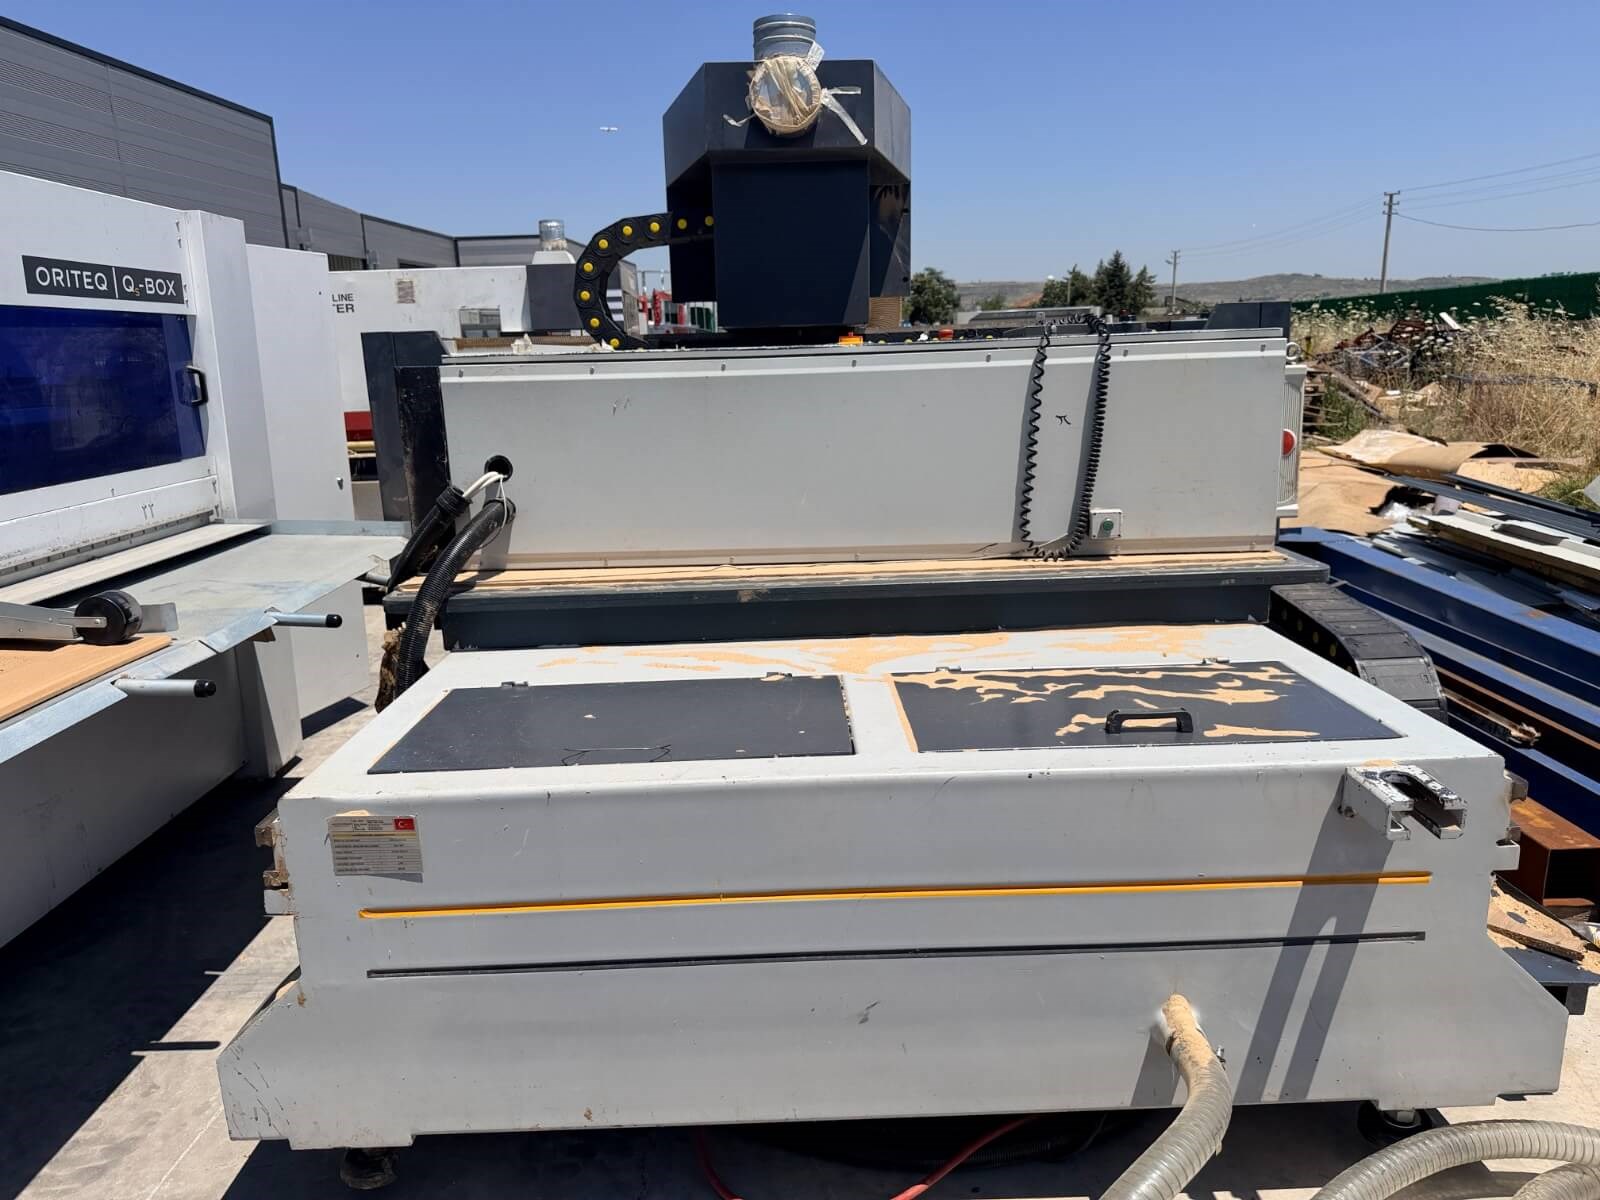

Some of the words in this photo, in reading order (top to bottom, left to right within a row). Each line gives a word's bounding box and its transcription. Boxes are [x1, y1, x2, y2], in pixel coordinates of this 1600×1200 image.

[35, 266, 108, 291] ORITEQ
[332, 294, 354, 303] LINE
[332, 303, 355, 313] ER
